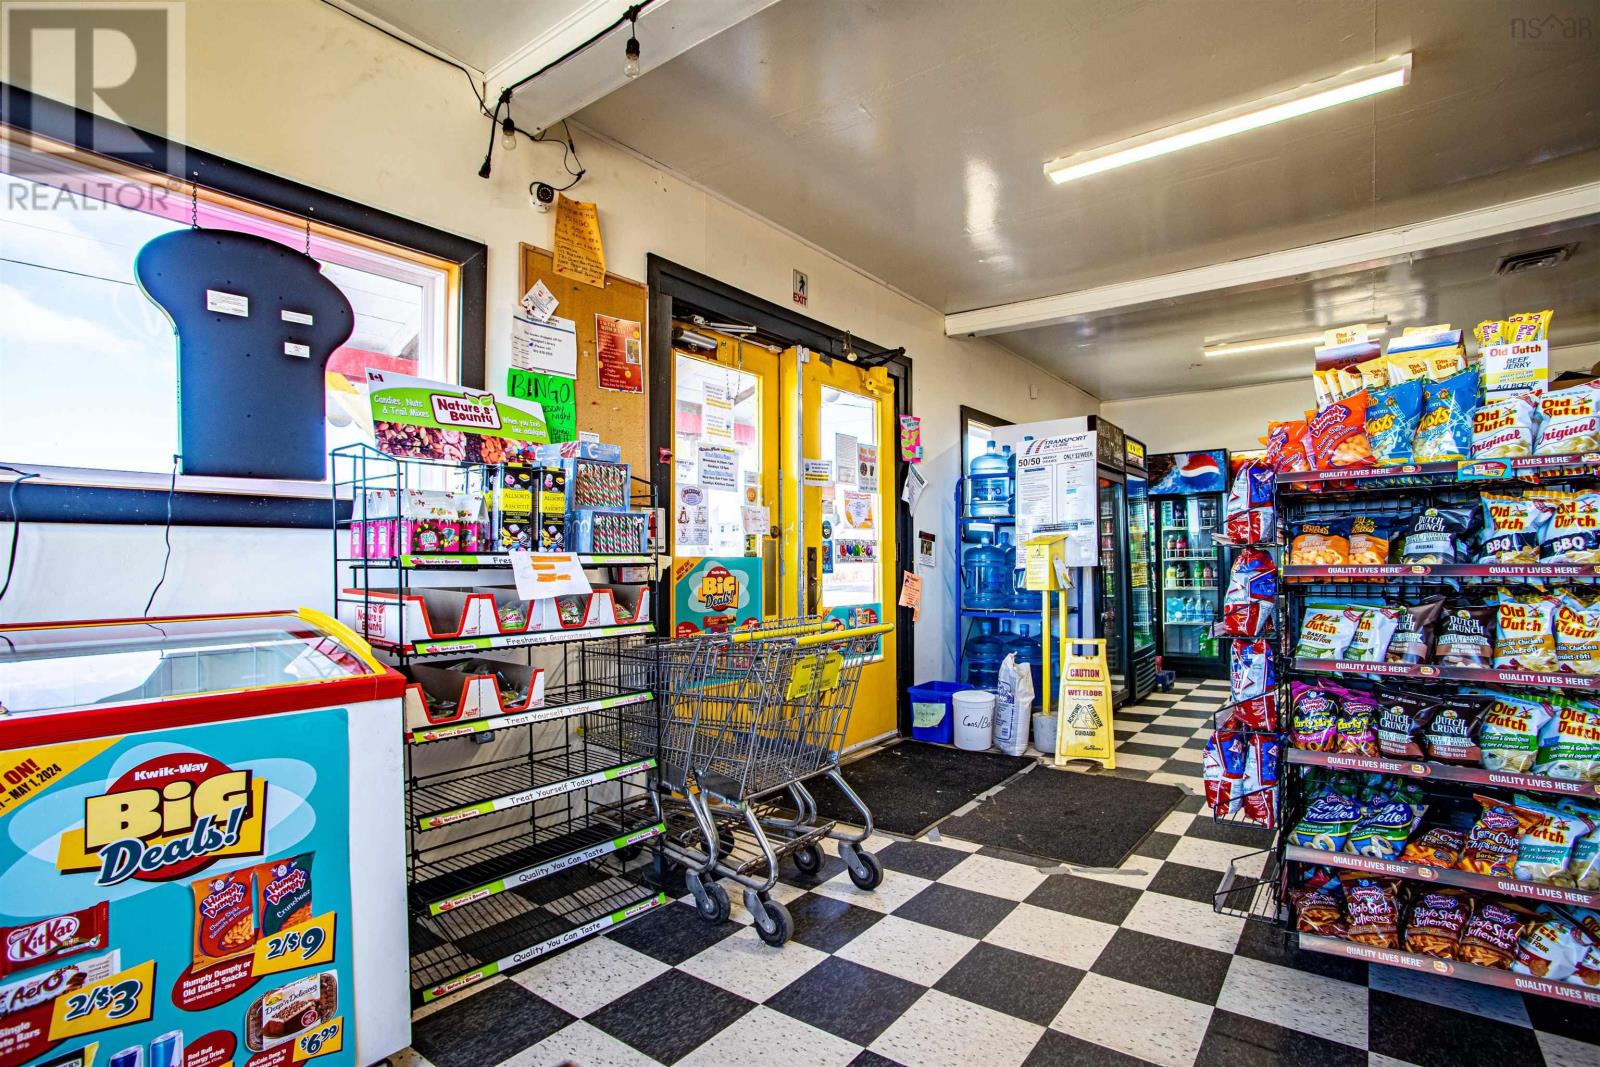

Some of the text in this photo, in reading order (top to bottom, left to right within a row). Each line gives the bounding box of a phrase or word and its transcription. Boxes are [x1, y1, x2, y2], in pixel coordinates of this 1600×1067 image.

[793, 292, 807, 306] EXIT
[1490, 344, 1541, 357] Old Dutch
[1504, 362, 1531, 370] JERKY
[511, 374, 570, 404] BINGO
[1542, 398, 1571, 409] Old
[450, 411, 494, 425] Bounty
[1311, 405, 1345, 429] Humpty
[1473, 409, 1500, 423] Old
[1473, 416, 1515, 433] Dutch
[1044, 435, 1087, 446] TRANSPORT
[1470, 429, 1521, 457] Original
[1018, 457, 1040, 467] 50/50
[1320, 470, 1348, 478] QUALITY
[1490, 505, 1510, 517] Old
[1414, 523, 1446, 532] CRUNCH
[1418, 515, 1444, 525] DUTCH
[1554, 515, 1596, 529] Dutch
[1487, 537, 1511, 553] BBQ
[1552, 536, 1586, 553] BBQ
[1489, 566, 1579, 574] QUALITY LIVES HERE
[704, 590, 735, 609] Deals!
[1313, 613, 1330, 622] Old
[1500, 604, 1526, 617] Old
[1305, 620, 1337, 634] Dutch
[1451, 615, 1480, 628] DUTCH
[1500, 617, 1542, 632] Dutch
[506, 631, 592, 645] Freshness Guaranteed
[1070, 668, 1100, 678] CAUTION
[1336, 662, 1365, 671] QUALITY
[1366, 664, 1386, 672] LIVES
[1499, 673, 1591, 686] QUALITY LIVES HERE
[504, 705, 590, 725] Treat Yourself Today
[1067, 703, 1082, 725] ACHTUNG
[1087, 704, 1104, 728] ATTENTION
[1491, 701, 1518, 716] Old
[1560, 708, 1588, 723] Old
[1383, 711, 1409, 723] DUTCH
[1435, 714, 1466, 727] DUTCH
[1487, 713, 1528, 732] Dutch
[1380, 718, 1410, 733] CRUNCH
[1431, 722, 1468, 736] CRUNCH
[1328, 756, 1400, 770] QUALITY LIVES HERE
[3, 758, 41, 785] ON!
[134, 762, 208, 781] Kwik-Way
[8, 782, 31, 800] MAY
[36, 763, 62, 782] 2024
[1489, 774, 1580, 791] QUALITY LIVES HERE
[510, 777, 593, 804] Treat Yourself Today
[1471, 826, 1496, 843] Corn
[95, 806, 247, 886] Deals!
[518, 847, 604, 882] Quality You Can Taste
[1333, 855, 1406, 873] QUALITY LIVES HERE
[267, 869, 306, 895] Humpty
[203, 883, 242, 909] Humpty
[267, 879, 306, 905] Dumpty
[1498, 881, 1590, 904] QUALITY LIVES HERE
[204, 893, 243, 918] Dumpty
[1414, 917, 1459, 931] Juliennes
[1438, 910, 1465, 924] Sticks
[1467, 927, 1511, 950] Juliennes
[1492, 923, 1517, 942] Sticks
[266, 926, 326, 960] 2/$9
[513, 923, 600, 963] Quality You Can Taste
[1346, 946, 1421, 967] QUALITY LIVES HERE
[183, 961, 252, 989] Humpty Dumpty or
[183, 971, 248, 998] Old Dutch Snacks
[1515, 978, 1582, 999] QUALITY LIVES
[65, 979, 142, 1021] 2/$3
[17, 1029, 40, 1042] Bars
[188, 1046, 212, 1060] Red Bull
[188, 1048, 225, 1067] Energy Drink
